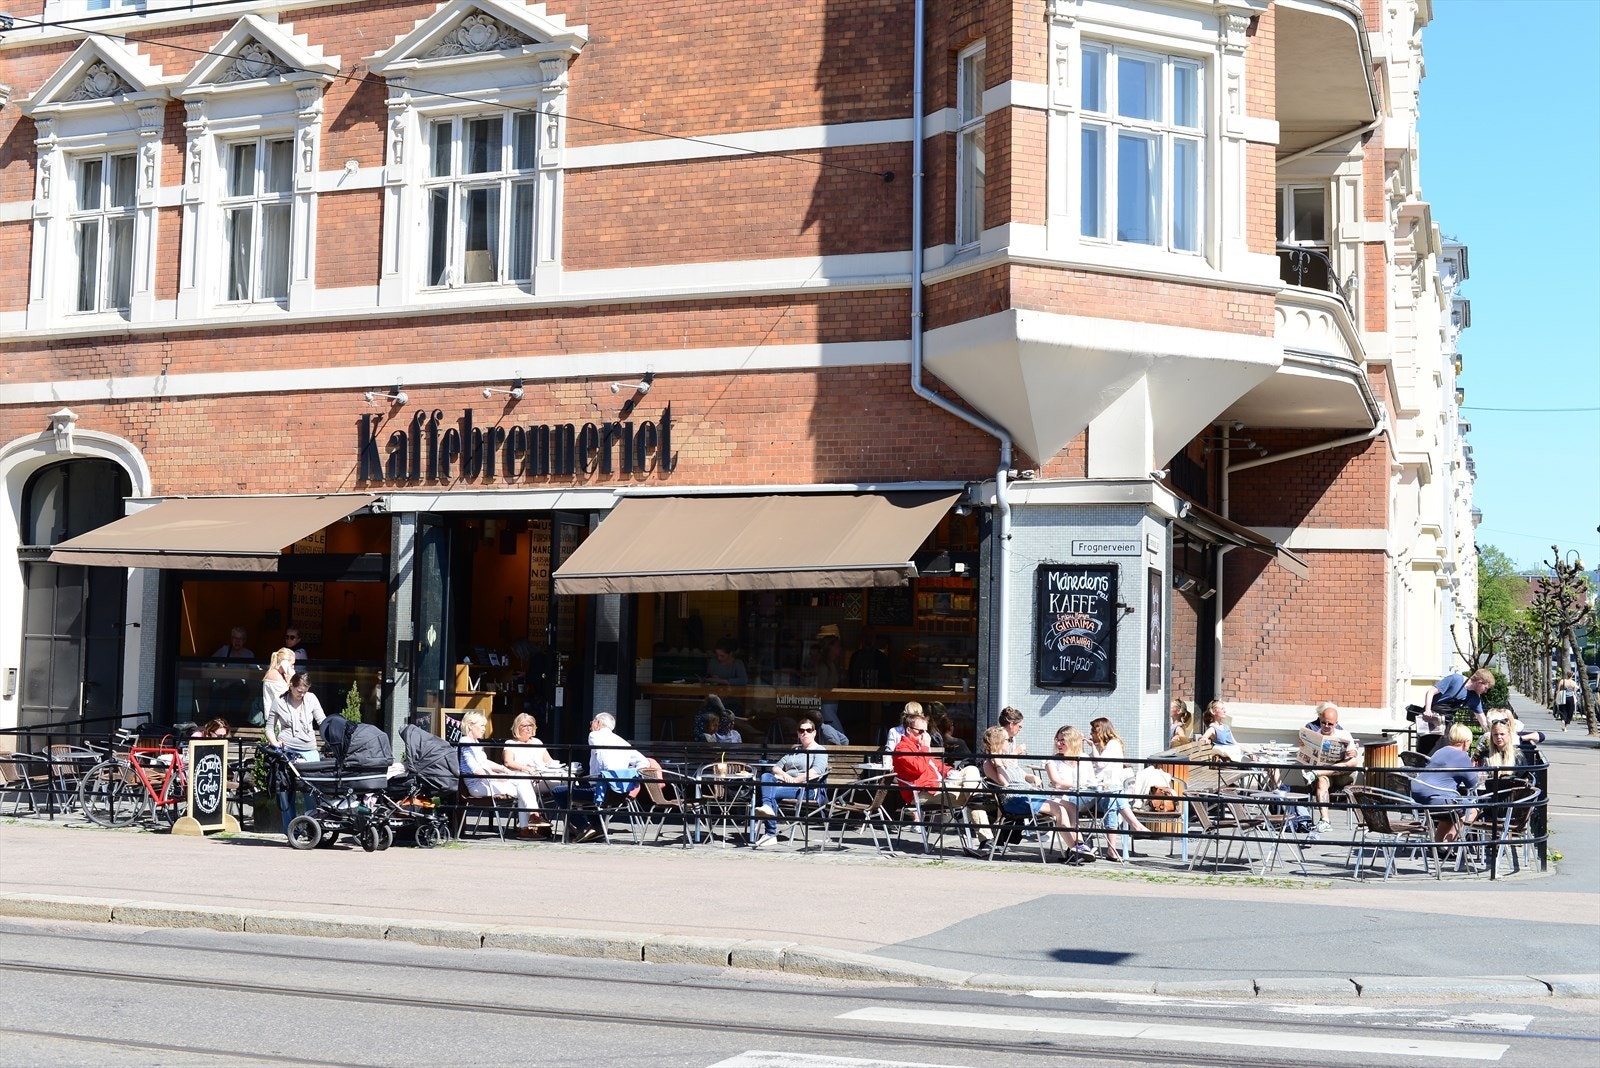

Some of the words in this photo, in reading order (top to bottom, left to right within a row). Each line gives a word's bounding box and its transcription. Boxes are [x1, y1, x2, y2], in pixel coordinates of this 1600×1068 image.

[357, 400, 678, 481] Kaffebrenneriet
[1078, 543, 1135, 553] Frognerveien
[1048, 570, 1109, 591] Månedens
[1049, 593, 1098, 614] KAFFE
[1055, 619, 1095, 632] GIKIRIMA
